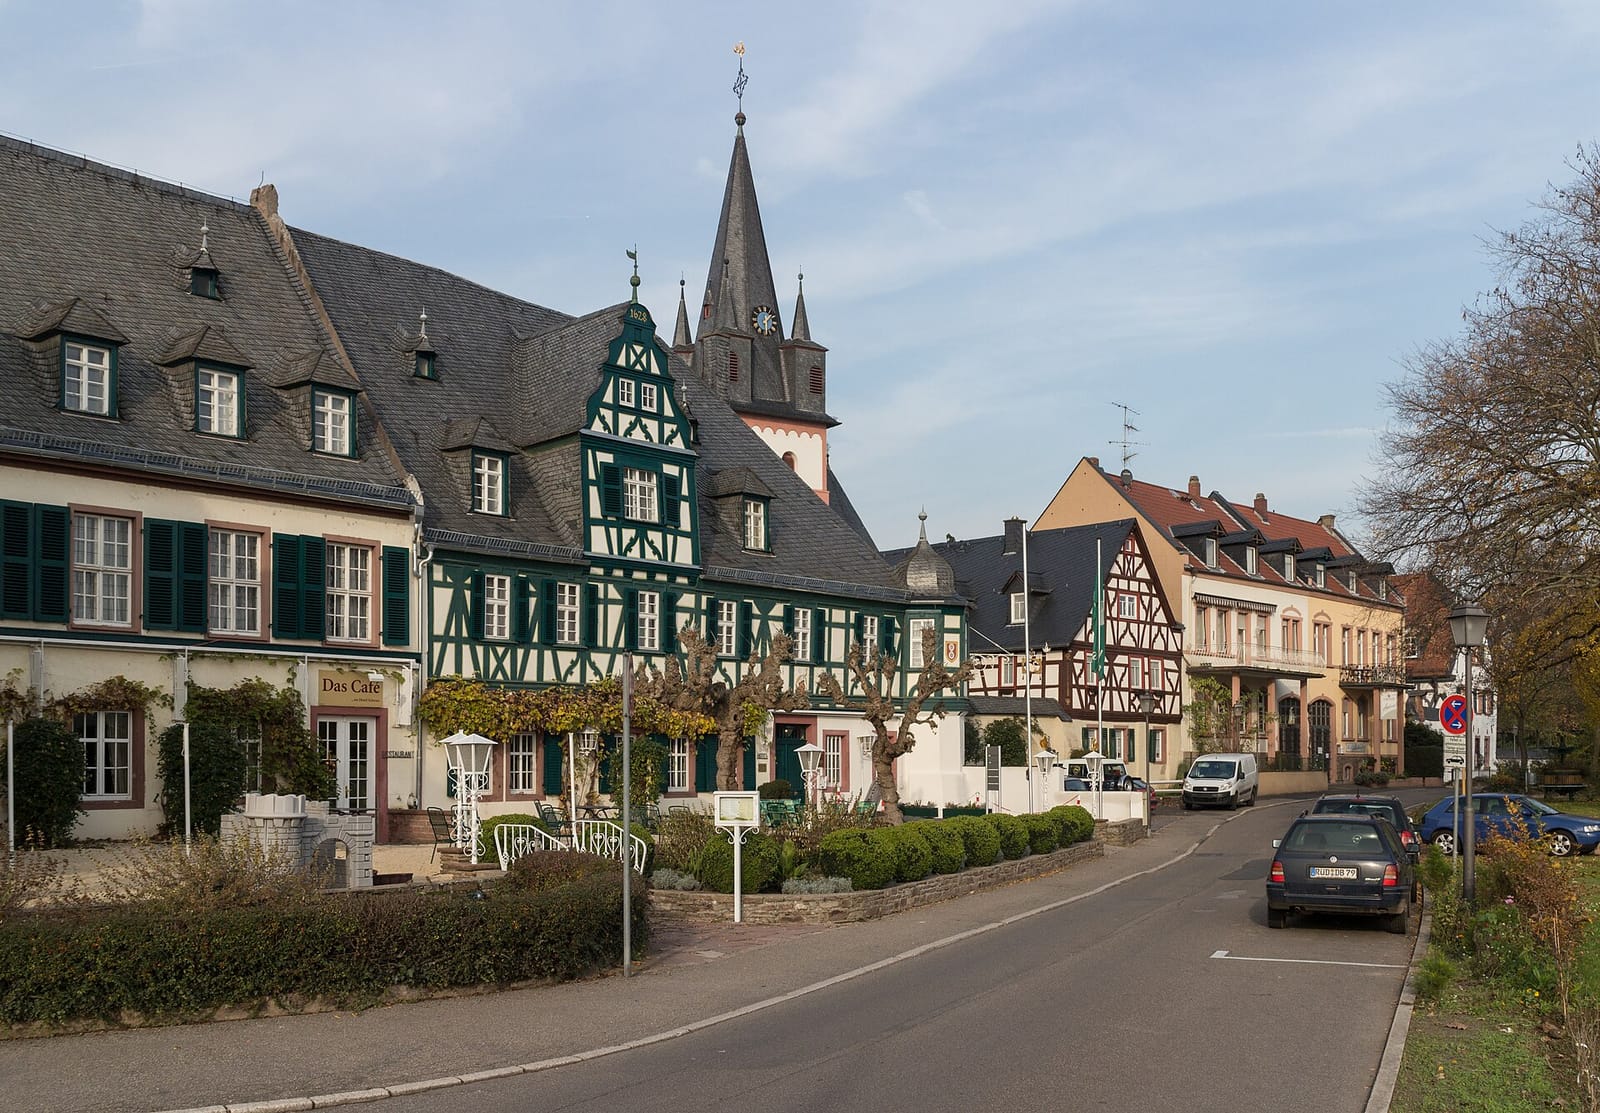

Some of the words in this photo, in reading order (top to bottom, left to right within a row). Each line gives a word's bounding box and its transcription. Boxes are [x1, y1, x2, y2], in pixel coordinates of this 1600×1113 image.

[630, 308, 647, 322] 1628
[322, 678, 347, 693] Das
[1346, 869, 1356, 877] 79
